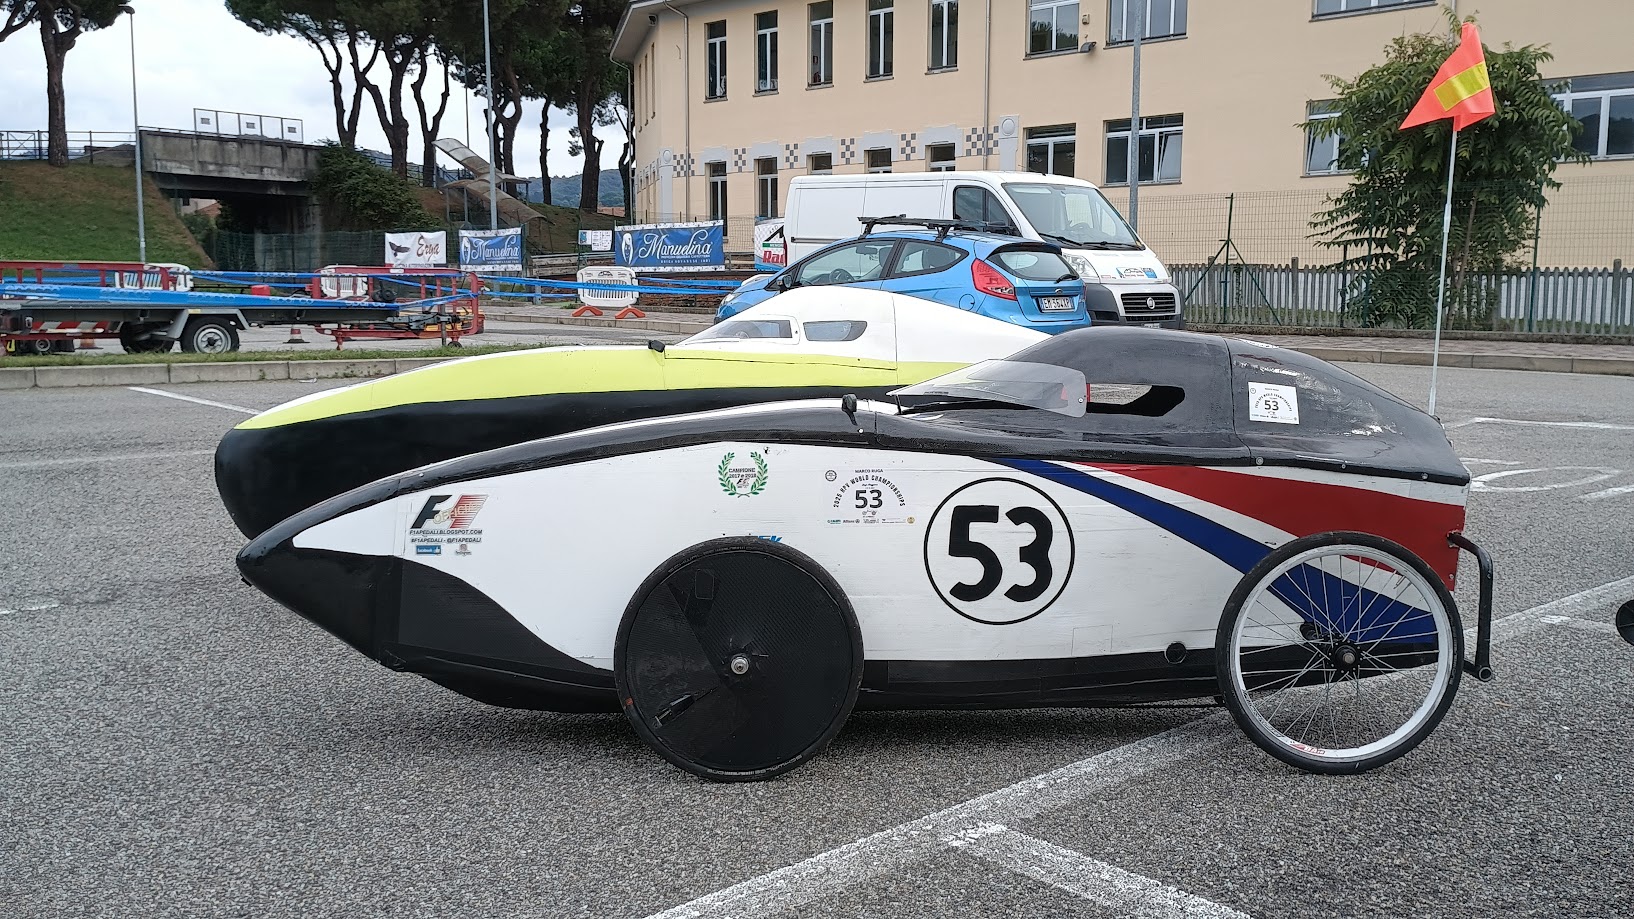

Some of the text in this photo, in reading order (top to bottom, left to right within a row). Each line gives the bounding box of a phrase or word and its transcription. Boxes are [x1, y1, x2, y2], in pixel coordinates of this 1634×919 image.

[471, 234, 520, 261] Manuelina
[638, 229, 712, 259] Manuelina
[1264, 400, 1279, 411] 53
[849, 474, 870, 485] WORLD
[854, 489, 884, 509] 53
[948, 505, 1053, 602] 53
